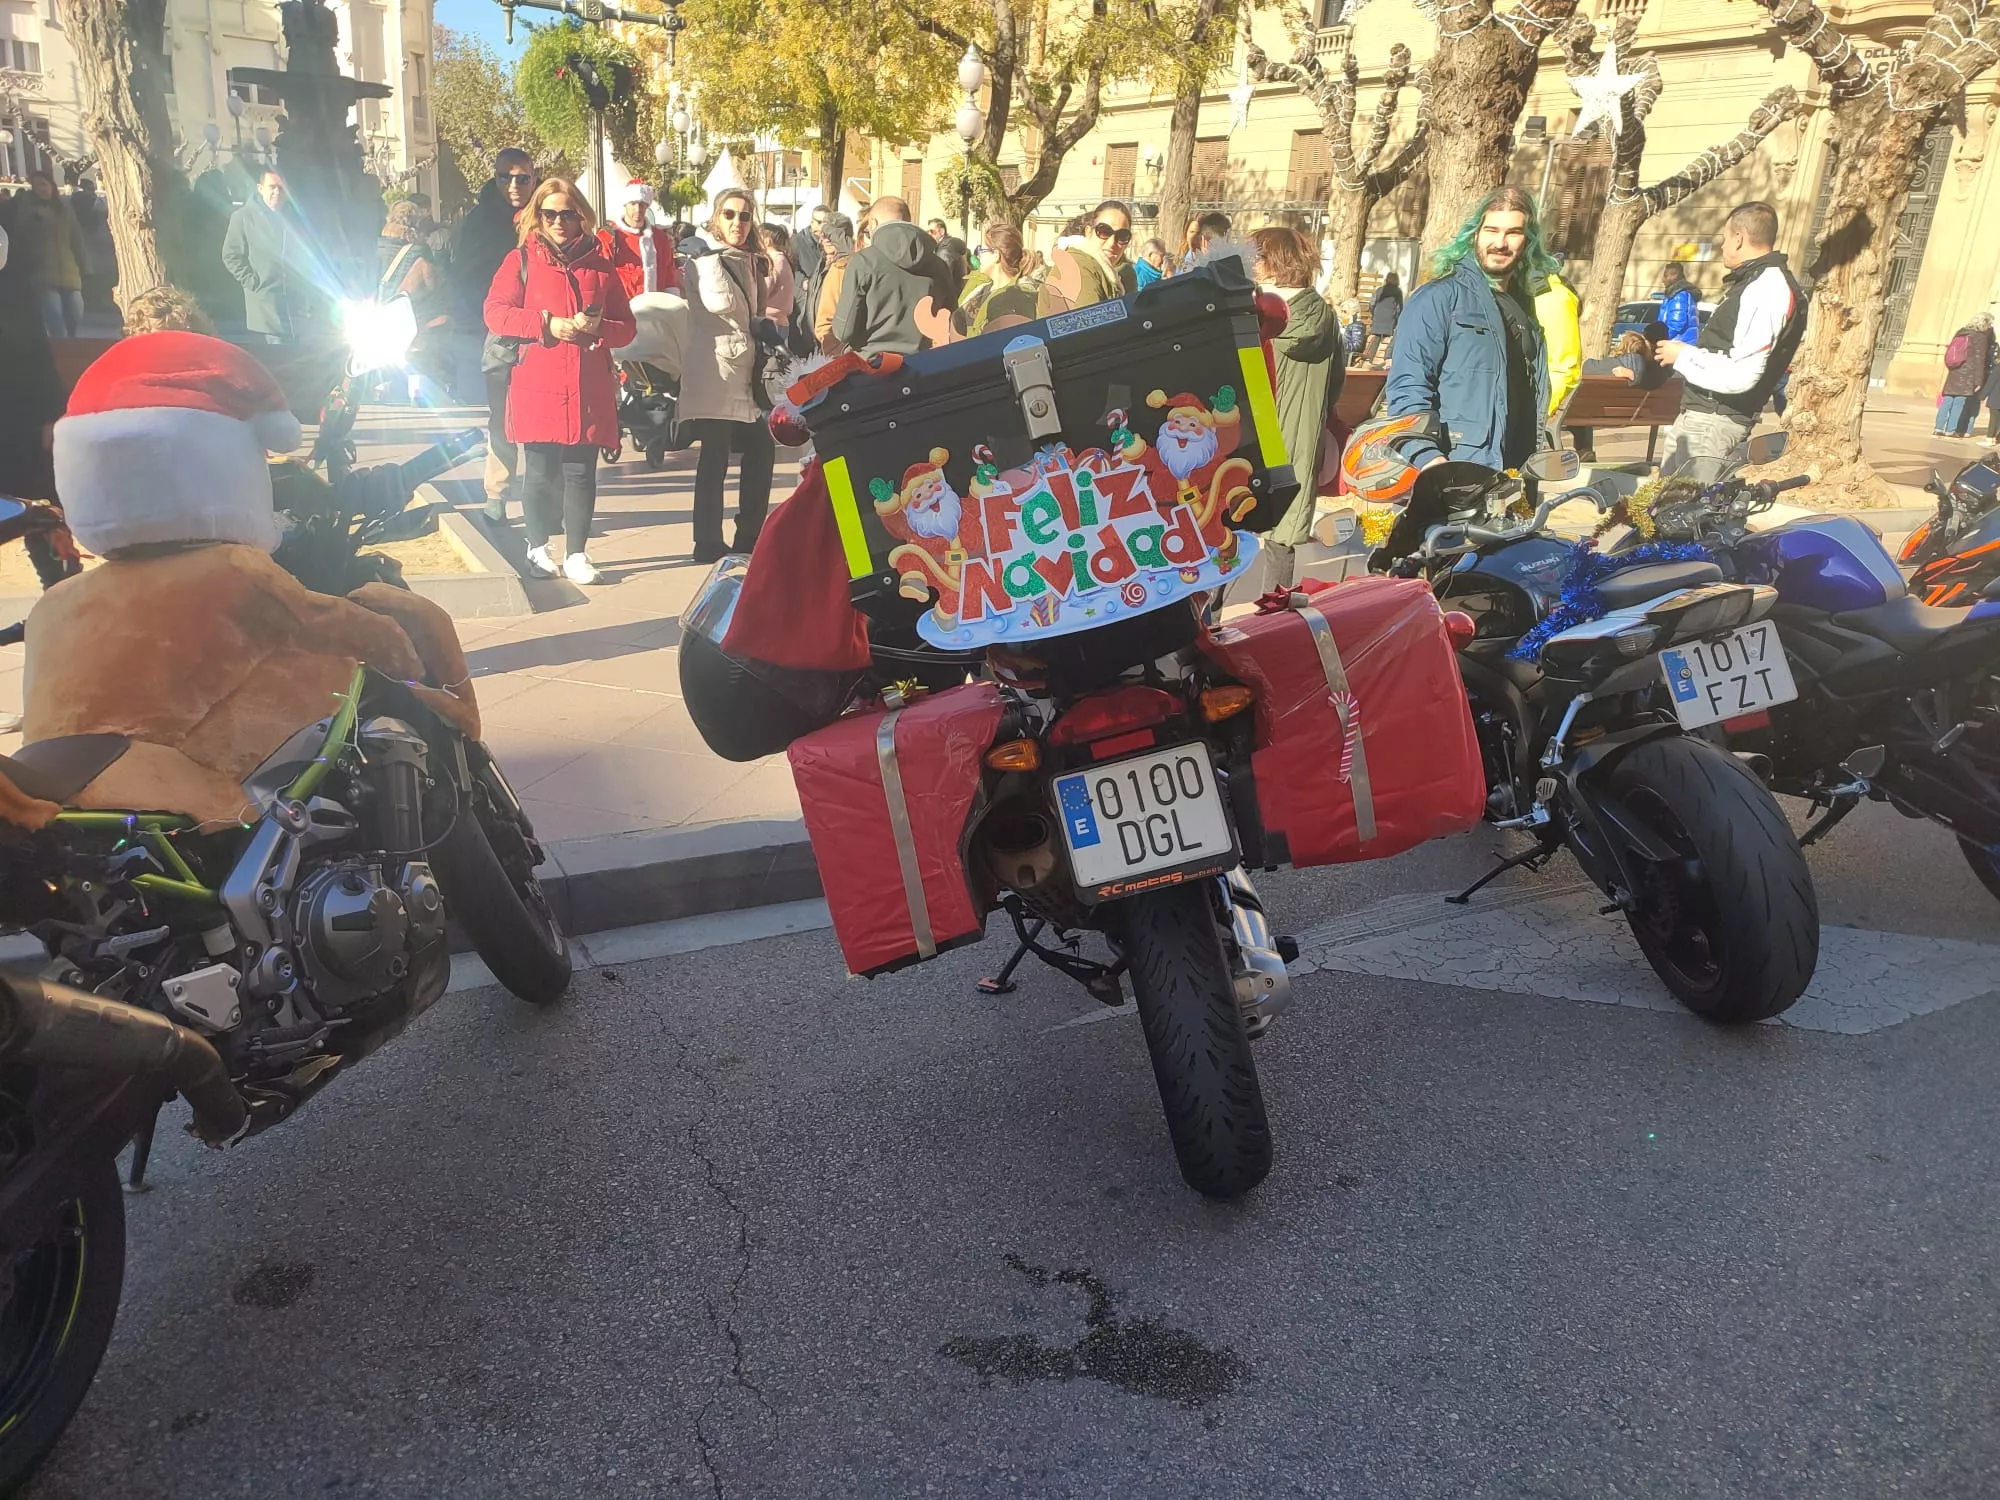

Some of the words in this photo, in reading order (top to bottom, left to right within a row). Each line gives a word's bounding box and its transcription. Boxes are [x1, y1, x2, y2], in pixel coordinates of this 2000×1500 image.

[961, 507, 1208, 622] Navidad
[1520, 554, 1561, 572] SUZUKI
[1693, 626, 1767, 678] 1017
[1677, 680, 1690, 693] E
[1706, 668, 1774, 716] FZT
[1095, 756, 1204, 820] 0100
[1074, 817, 1090, 835] E
[1117, 809, 1203, 866] DGL
